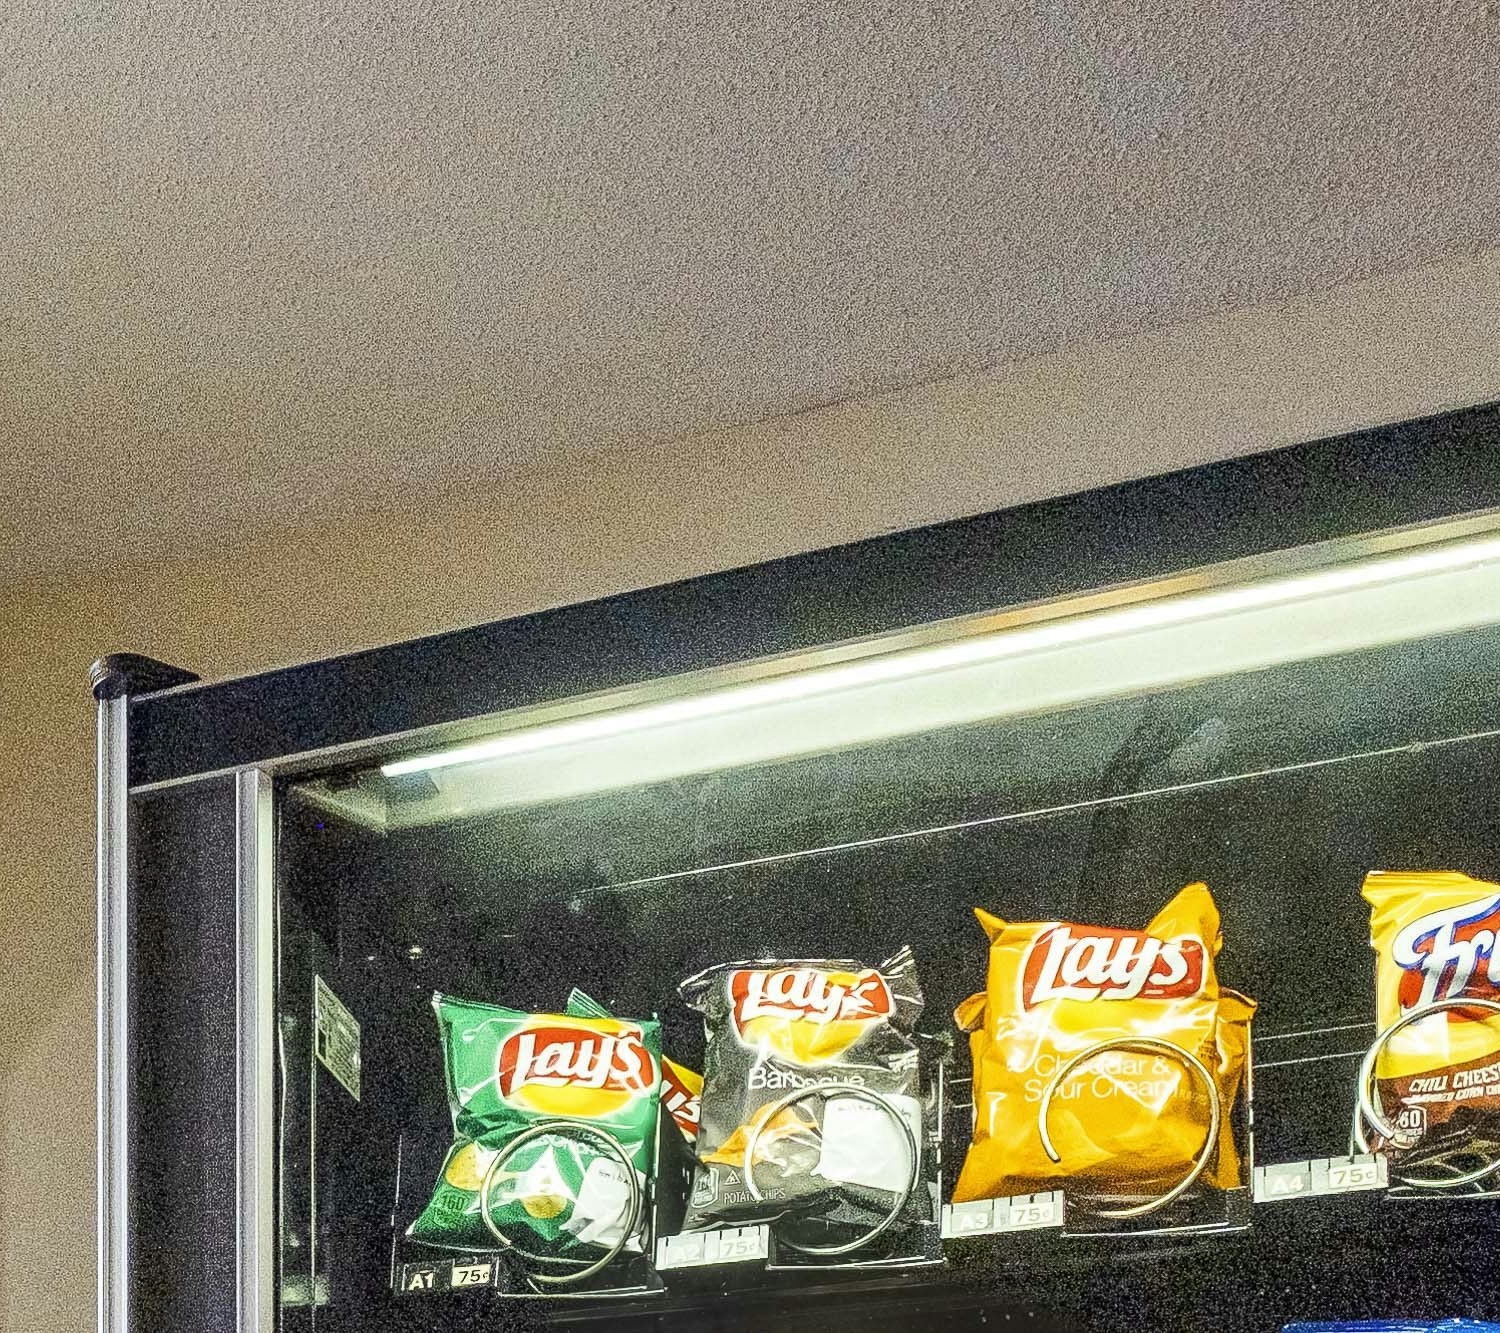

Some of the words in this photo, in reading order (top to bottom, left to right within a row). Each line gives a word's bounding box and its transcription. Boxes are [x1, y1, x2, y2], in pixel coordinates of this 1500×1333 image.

[1152, 1056, 1170, 1074] &
[1024, 1080, 1090, 1103] Sour
[1409, 1076, 1448, 1092] CHILI
[1273, 1176, 1303, 1193] A4
[960, 1214, 989, 1229] A3
[408, 1272, 434, 1291] A1
